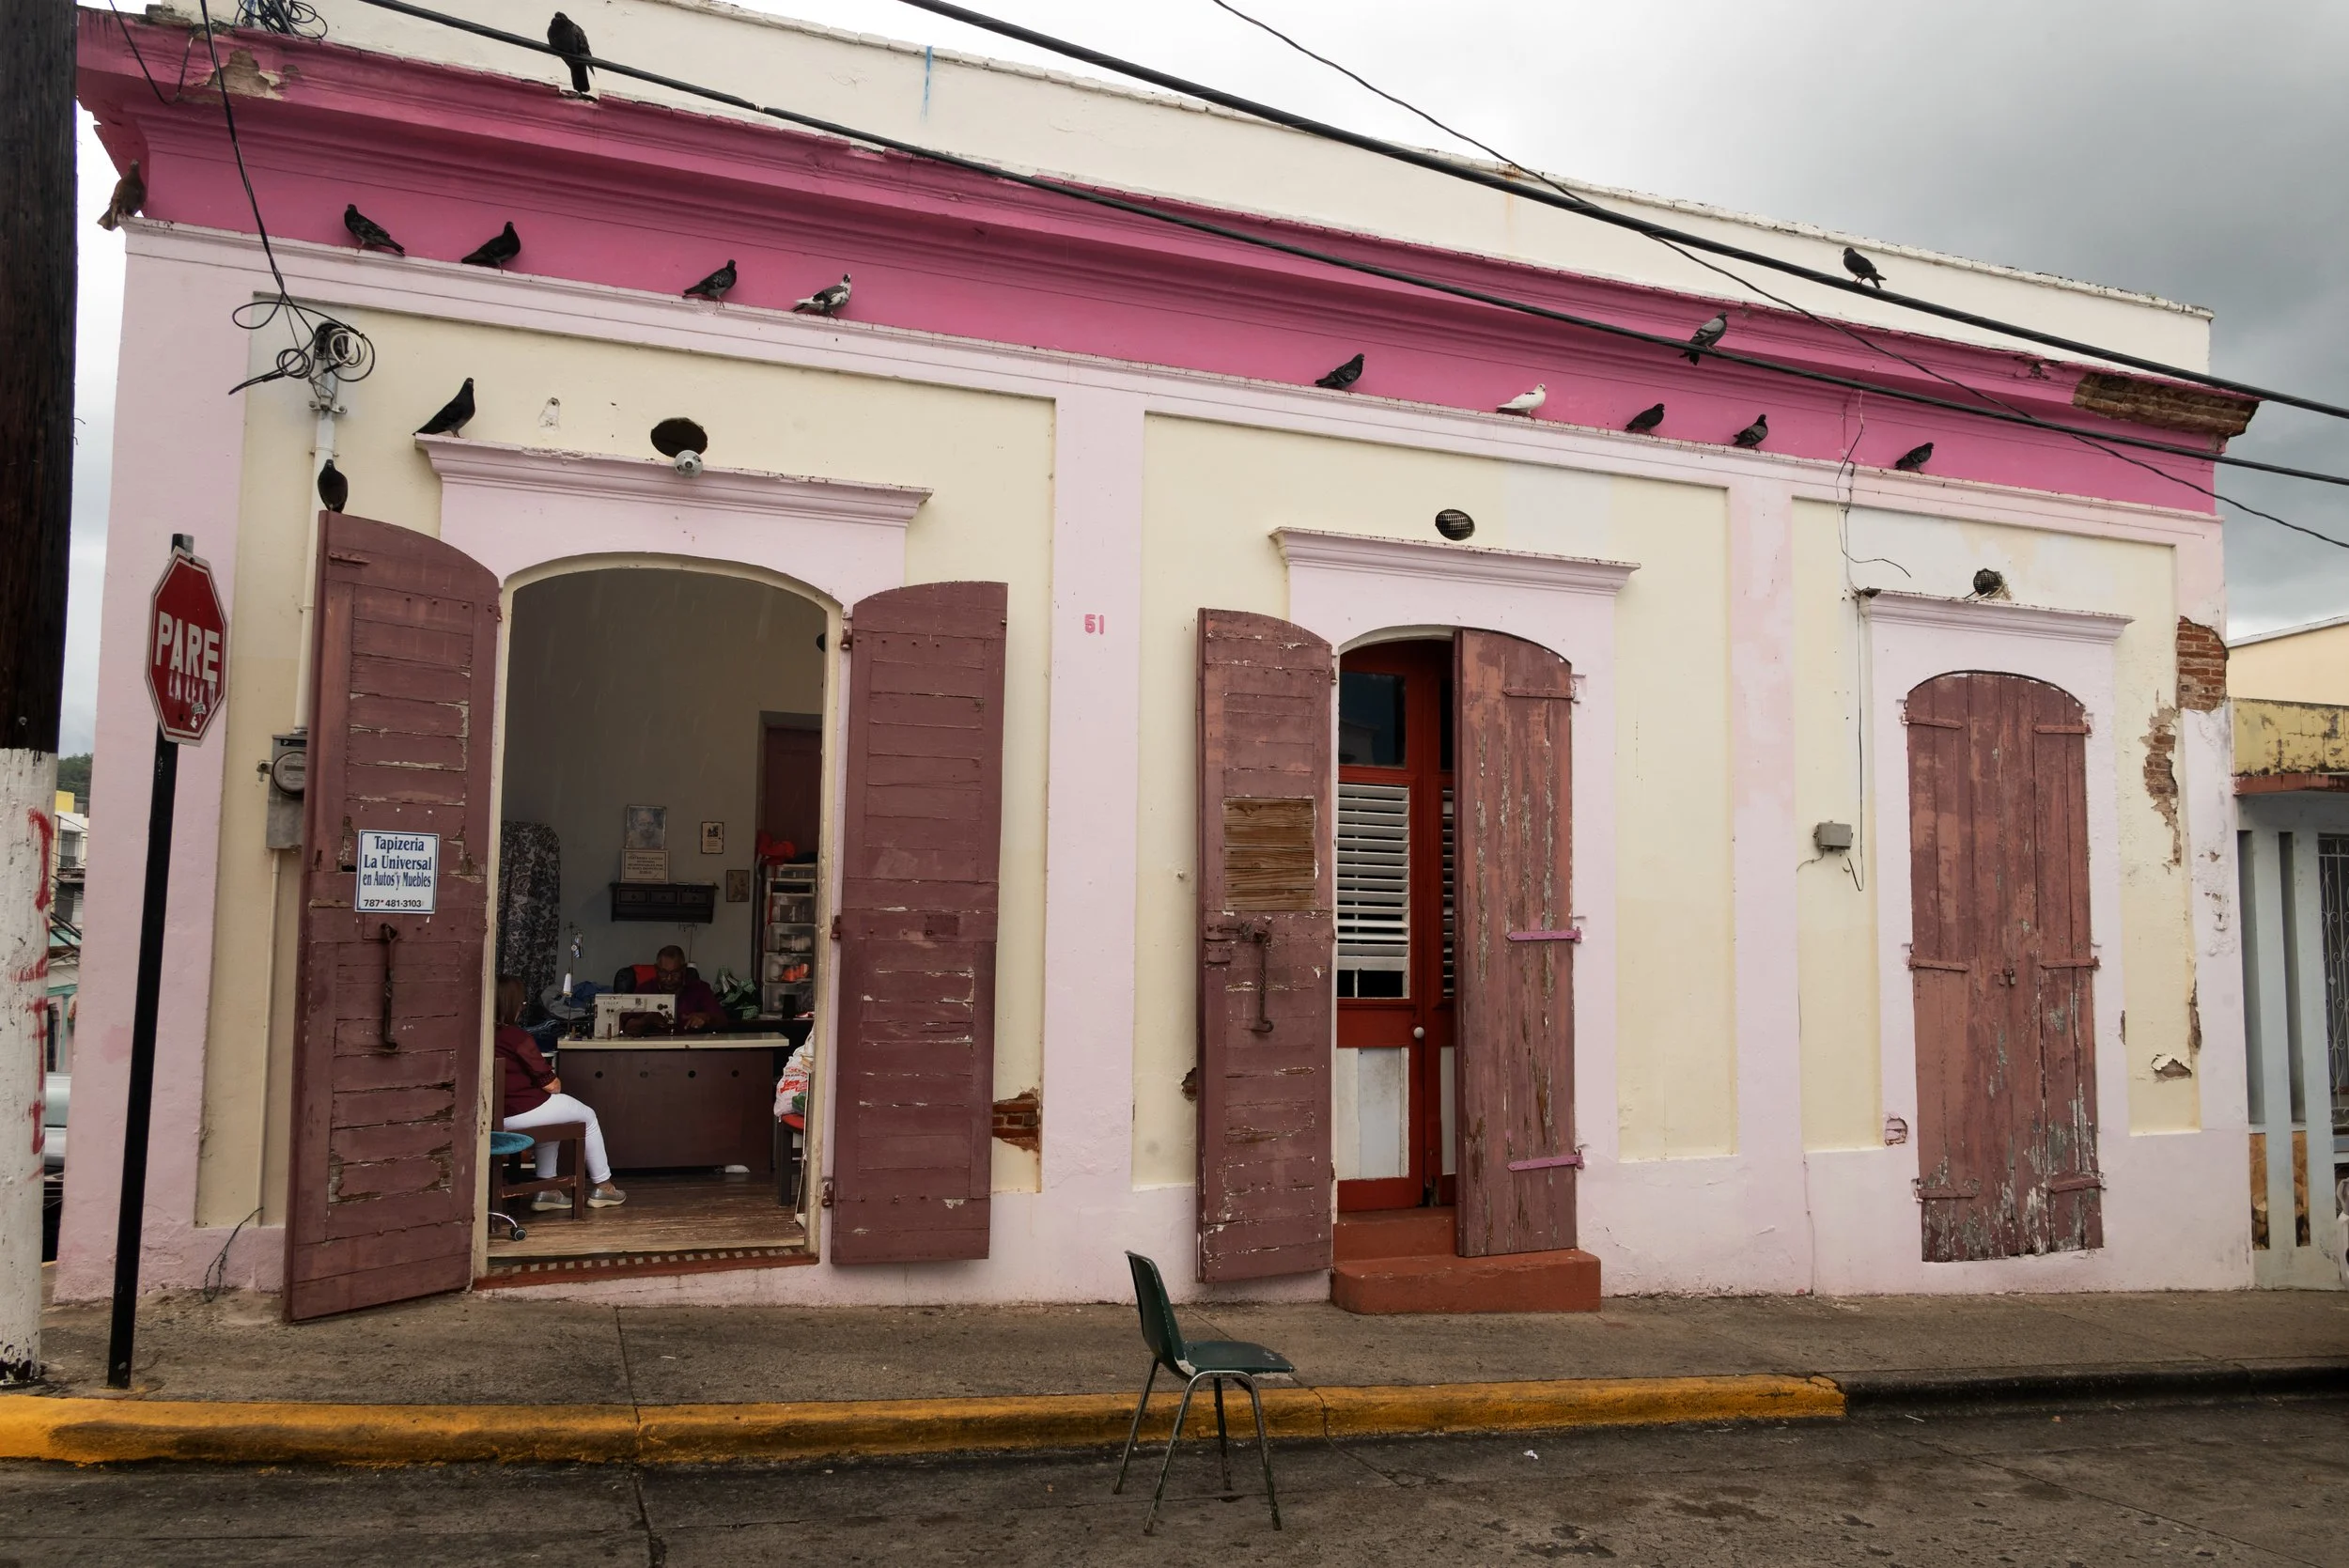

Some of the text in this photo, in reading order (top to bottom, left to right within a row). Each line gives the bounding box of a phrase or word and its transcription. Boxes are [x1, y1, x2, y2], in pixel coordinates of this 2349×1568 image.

[1084, 613, 1104, 635] 51
[155, 611, 220, 683] PARE
[364, 854, 432, 871] La Universal
[363, 871, 431, 891] en Autos y Muebles
